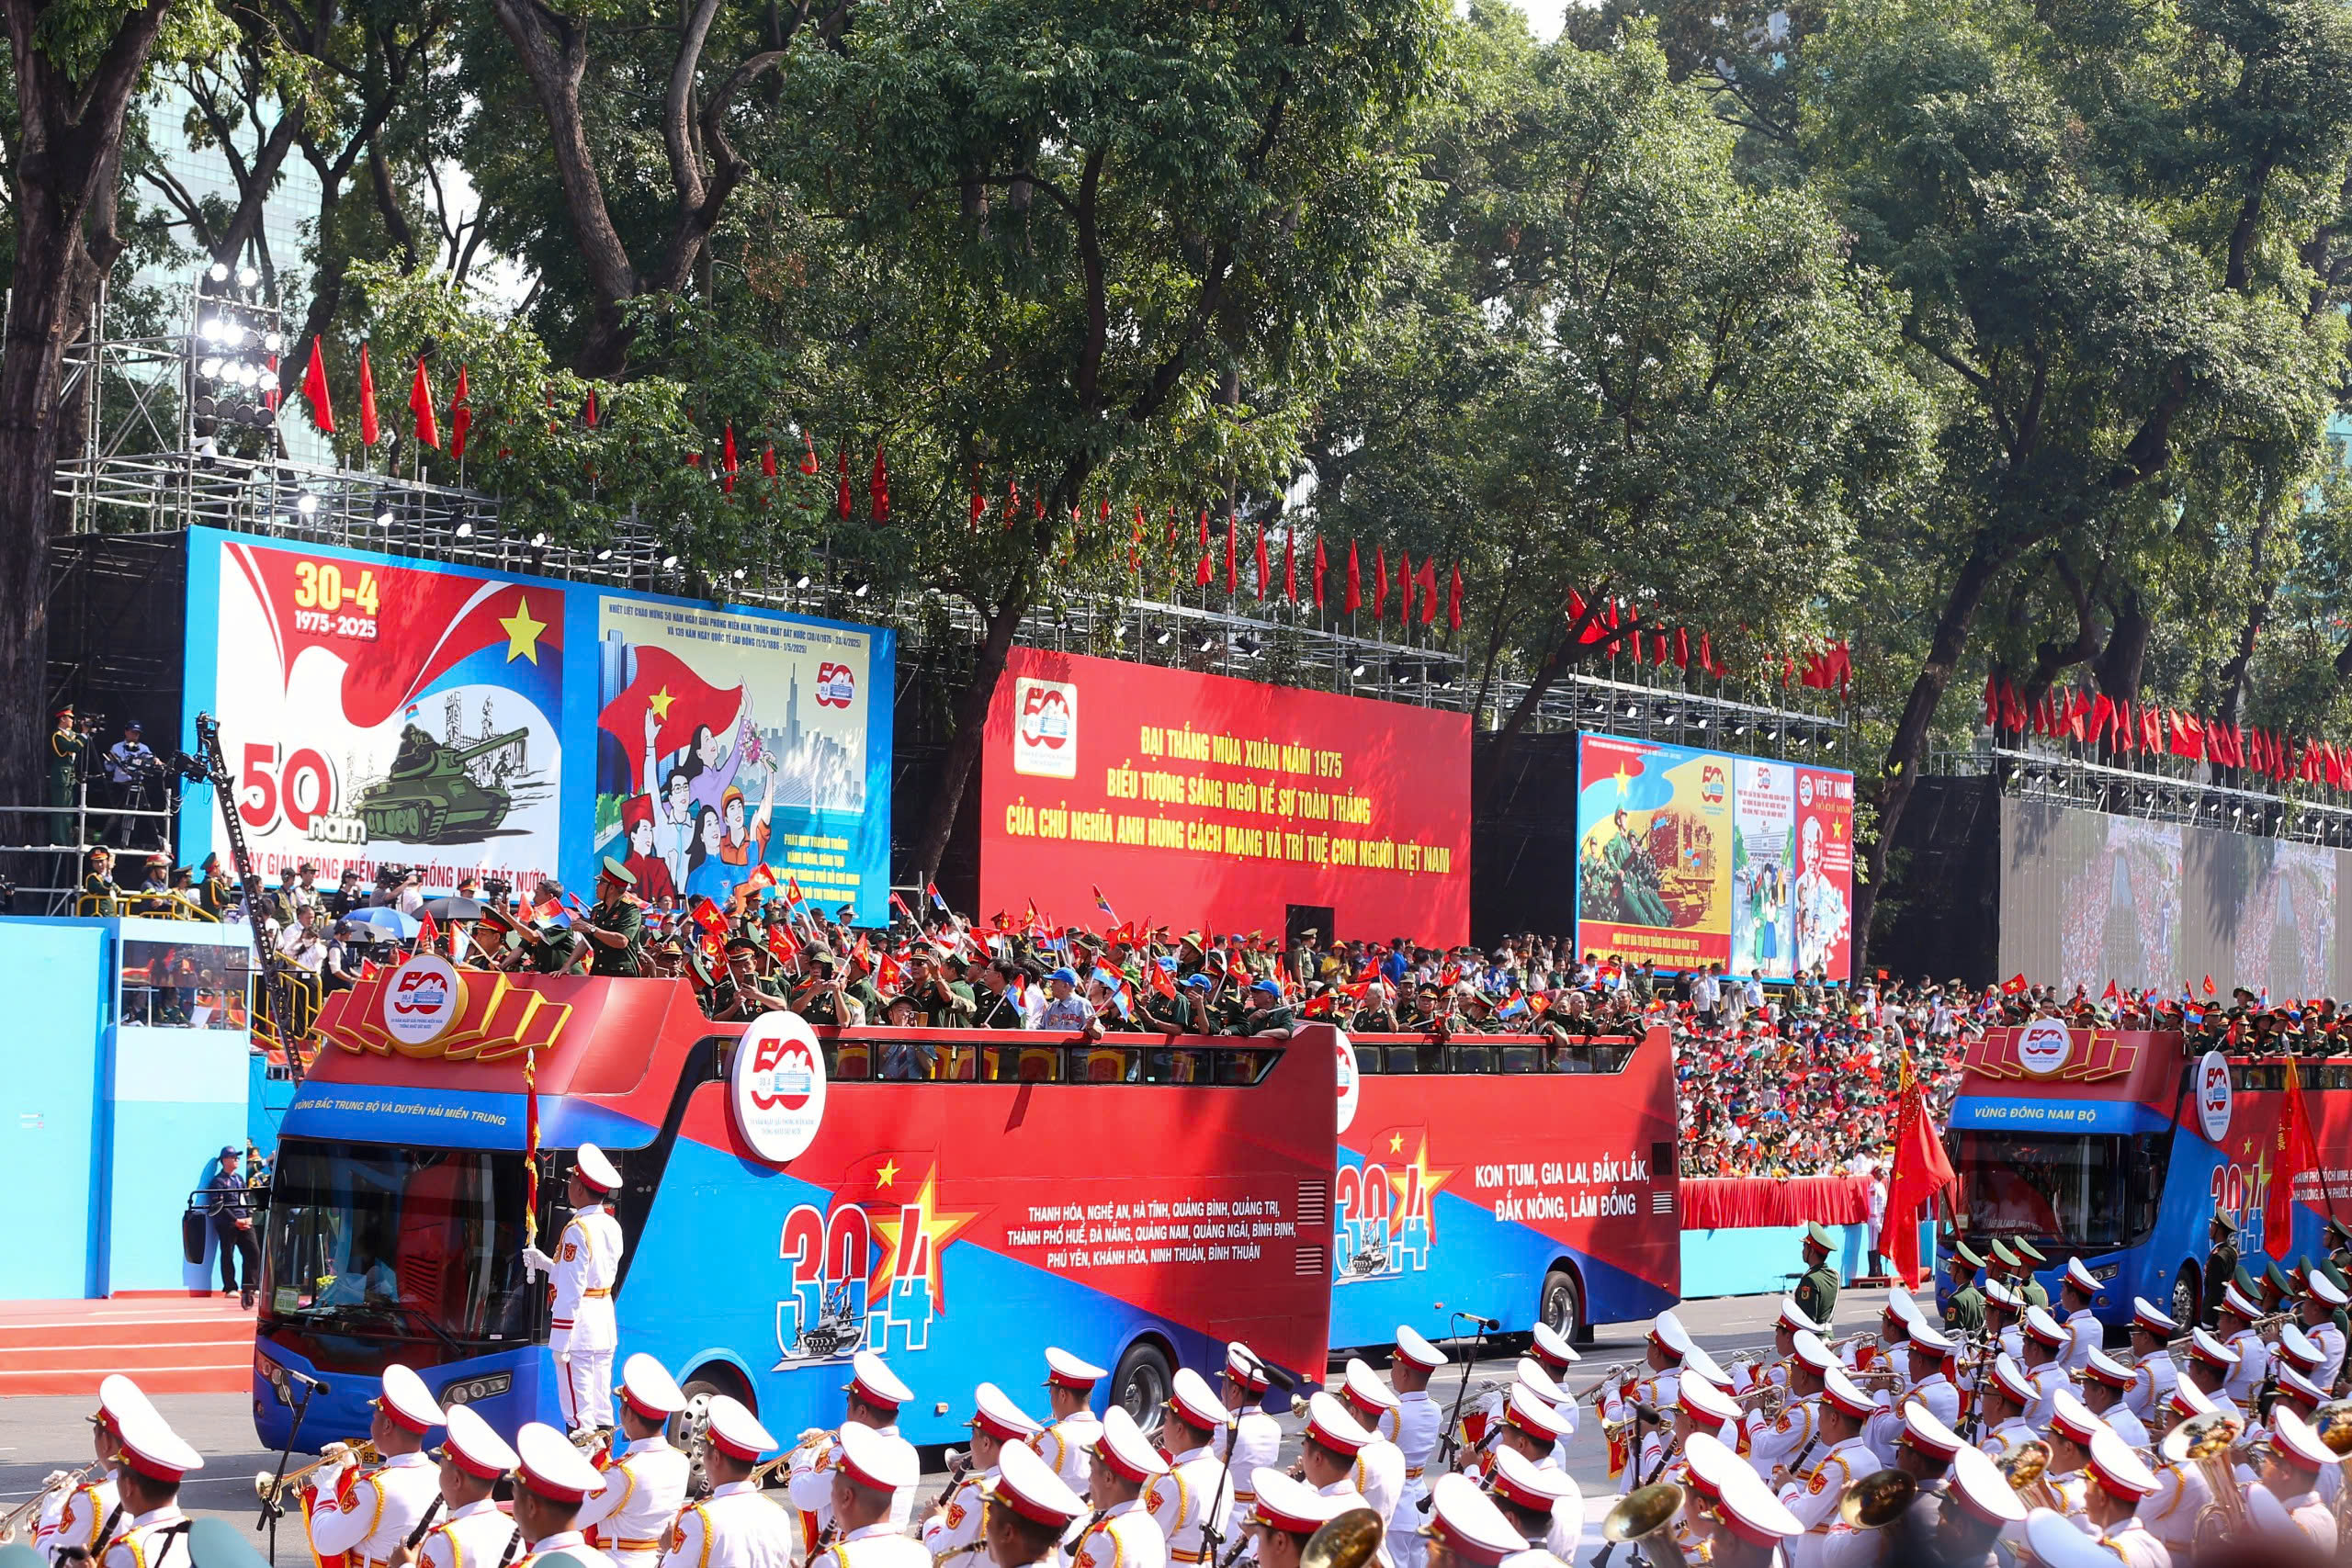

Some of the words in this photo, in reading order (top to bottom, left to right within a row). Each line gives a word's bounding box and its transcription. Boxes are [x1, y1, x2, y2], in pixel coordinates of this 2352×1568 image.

[294, 560, 379, 616] 30-4
[664, 611, 671, 621] 50
[1141, 726, 1163, 761] ĐẠI
[1167, 720, 1209, 761] THẮNG
[1213, 731, 1241, 765] MÙA
[1245, 737, 1279, 771] XUÂN
[1283, 741, 1310, 774] NĂM
[1314, 750, 1342, 779] 1975
[239, 742, 331, 831] 50
[1107, 758, 1138, 799] BIỂU
[1141, 771, 1185, 808] TƯỢNG
[1188, 773, 1223, 808] SÁNG
[1227, 778, 1256, 812] NGỜI
[1260, 779, 1275, 815] VỀ
[1278, 787, 1296, 822] SỰ
[1298, 787, 1329, 820] TOÀN
[1332, 786, 1371, 824] THẮNG
[1815, 775, 1833, 800] VIỆT
[1835, 781, 1851, 799] NAM
[308, 810, 368, 844] năm
[1006, 795, 1035, 836] CỦA
[1039, 801, 1068, 839] CHỦ
[1070, 808, 1114, 843] NGHĨA
[1116, 815, 1145, 845] ANH
[1148, 813, 1184, 849] HÙNG
[1188, 818, 1222, 852] CÁCH
[1225, 827, 1262, 862] MẠNG
[1266, 827, 1282, 859] VÀ
[1284, 829, 1304, 862] TRÍ
[1306, 831, 1329, 870] TUỆ
[1331, 838, 1355, 866] CON
[1360, 836, 1395, 870] NGƯỜI
[1397, 840, 1420, 876] VIỆT
[1424, 845, 1450, 874] NAM
[394, 972, 447, 1014] 50
[751, 1038, 814, 1110] 50
[295, 1099, 314, 1110] VÙNG
[315, 1097, 334, 1109] BẮC
[334, 1100, 364, 1111] TRUNG
[366, 1100, 379, 1113] BỘ
[381, 1101, 392, 1112] VÀ
[394, 1103, 426, 1115] DUYÊN
[426, 1104, 444, 1116] HẢI
[445, 1107, 469, 1119] MIỀN
[470, 1111, 506, 1126] TRUNG
[1974, 1106, 2007, 1117] VÙNG
[2010, 1106, 2044, 1119] ĐÔNG
[2047, 1110, 2075, 1120] NAM
[2077, 1110, 2096, 1122] BỘ
[1476, 1165, 1503, 1188] KON
[1507, 1164, 1538, 1189] TUM,
[1542, 1162, 1564, 1184] GIA
[1567, 1162, 1589, 1187] LAI,
[1593, 1152, 1619, 1183] ĐẮK
[1623, 1151, 1650, 1184] LẮK,
[1029, 1207, 1060, 1222] THANH
[1063, 1201, 1085, 1223] HÓA,
[1088, 1201, 1114, 1222] NGHỆ
[1115, 1205, 1131, 1221] AN,
[1134, 1201, 1146, 1218] HÀ
[1148, 1200, 1170, 1220] TĨNH,
[1172, 1197, 1204, 1217] QUẢNG
[1206, 1199, 1230, 1218] BÌNH,
[1232, 1197, 1262, 1216] QUẢNG
[1264, 1201, 1280, 1217] TRỊ,
[1335, 1164, 1430, 1277] 30.4
[1496, 1190, 1523, 1222] ĐẮK
[1527, 1191, 1568, 1222] NÔNG,
[1571, 1190, 1597, 1217] LÂM
[1600, 1186, 1636, 1216] ĐỒNG
[1007, 1227, 1040, 1246] THÀNH
[1044, 1224, 1064, 1245] PHỐ
[1066, 1223, 1087, 1245] HUẾ,
[1090, 1224, 1102, 1243] ĐÀ
[1104, 1222, 1133, 1244] NẴNG,
[1136, 1221, 1167, 1241] QUẢNG
[1169, 1224, 1191, 1241] NAM,
[1193, 1219, 1225, 1238] QUẢNG
[1227, 1221, 1250, 1239] NGÃI,
[1252, 1220, 1272, 1237] BÌNH
[1274, 1223, 1296, 1239] ĐỊNH,
[1047, 1249, 1067, 1268] PHÚ
[1069, 1248, 1091, 1269] YÊN,
[1093, 1247, 1125, 1266] KHÁNH
[1127, 1246, 1148, 1265] HÒA,
[1150, 1248, 1171, 1262] NINH
[1174, 1244, 1205, 1264] THUẬN,
[1208, 1243, 1229, 1260] BÌNH
[1232, 1242, 1260, 1261] THUẬN
[776, 1203, 933, 1359] 30.4
